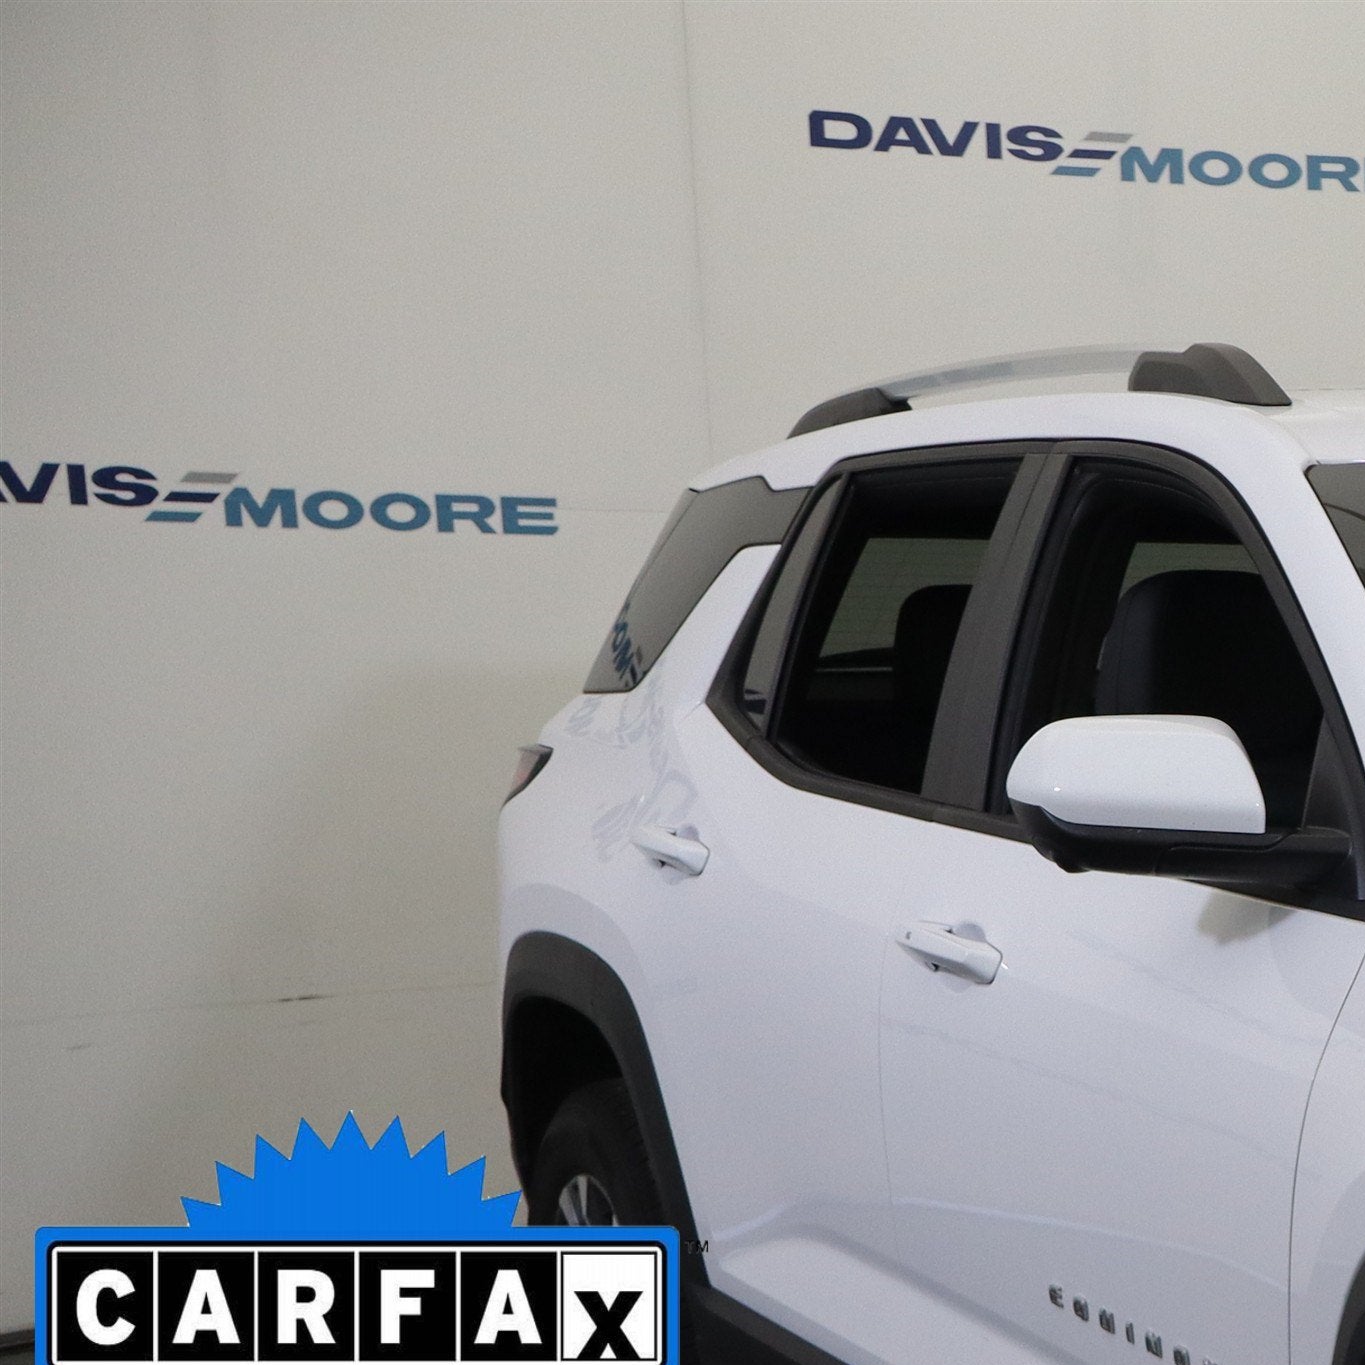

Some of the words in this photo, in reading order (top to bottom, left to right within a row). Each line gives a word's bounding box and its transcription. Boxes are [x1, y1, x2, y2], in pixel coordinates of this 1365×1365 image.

[808, 108, 1064, 161] DAVIS
[0, 459, 159, 506] VIS
[224, 485, 559, 537] MOORE
